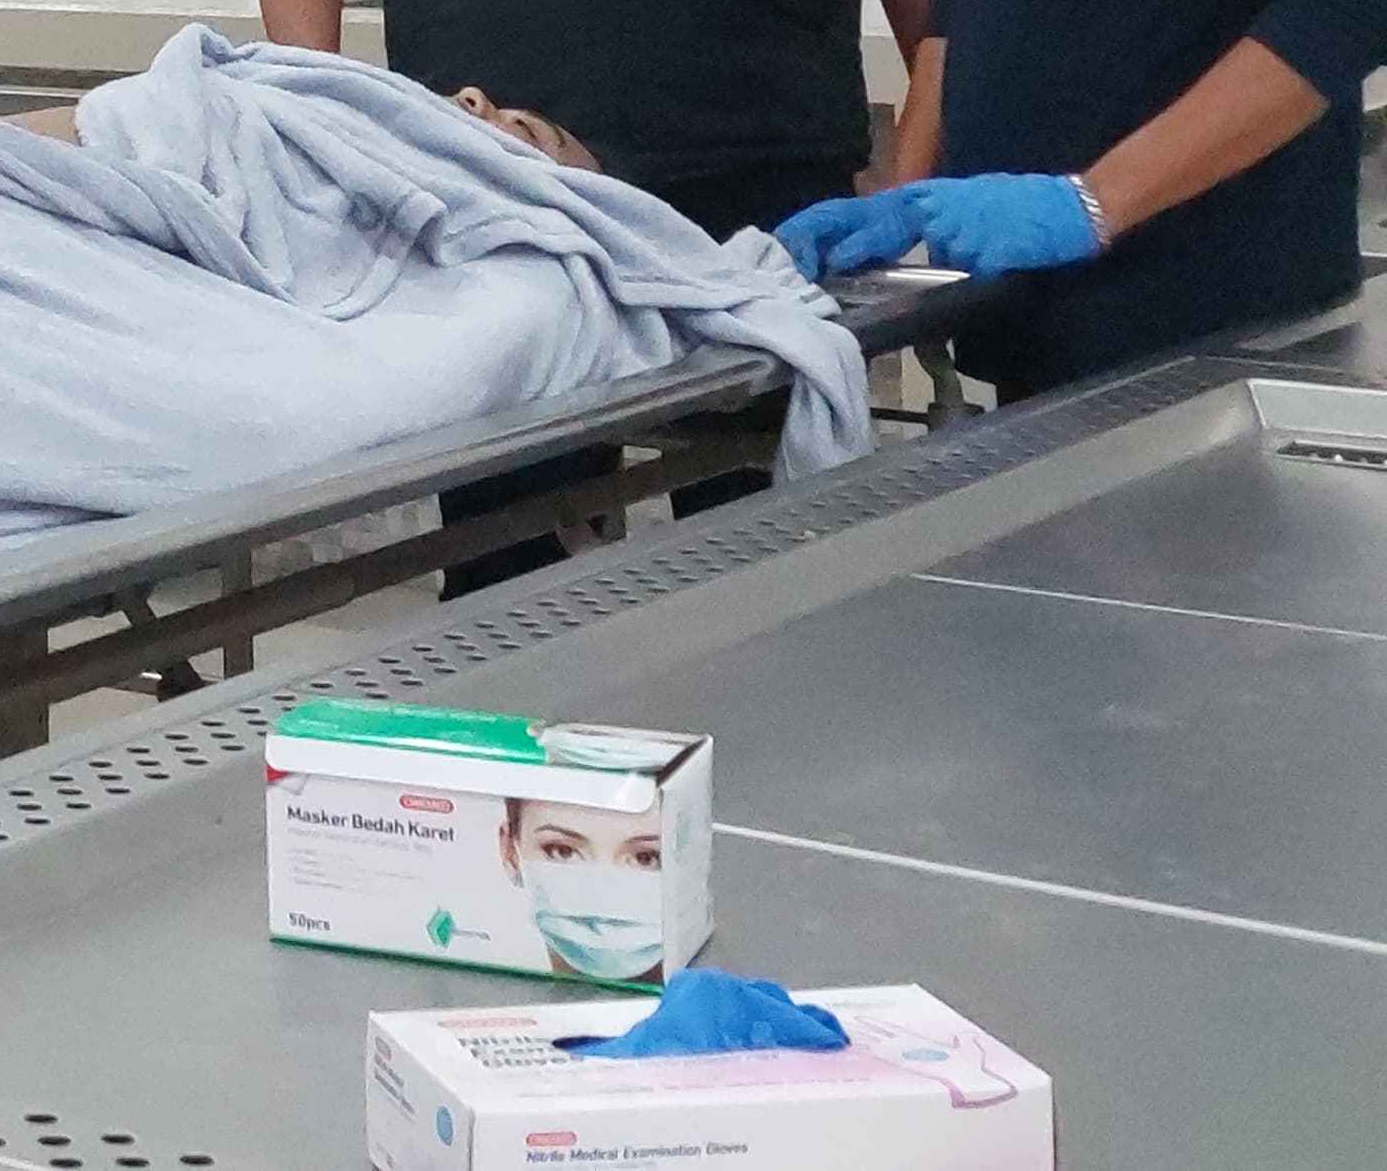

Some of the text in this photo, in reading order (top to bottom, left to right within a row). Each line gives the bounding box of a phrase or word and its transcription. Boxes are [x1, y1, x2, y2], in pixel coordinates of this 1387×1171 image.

[287, 806, 348, 828] Masker
[352, 813, 405, 835] Bedah
[408, 820, 455, 842] Karet
[289, 912, 331, 932] 50pcs
[526, 1142, 749, 1163] Nitrile Medical Examination Gloves
